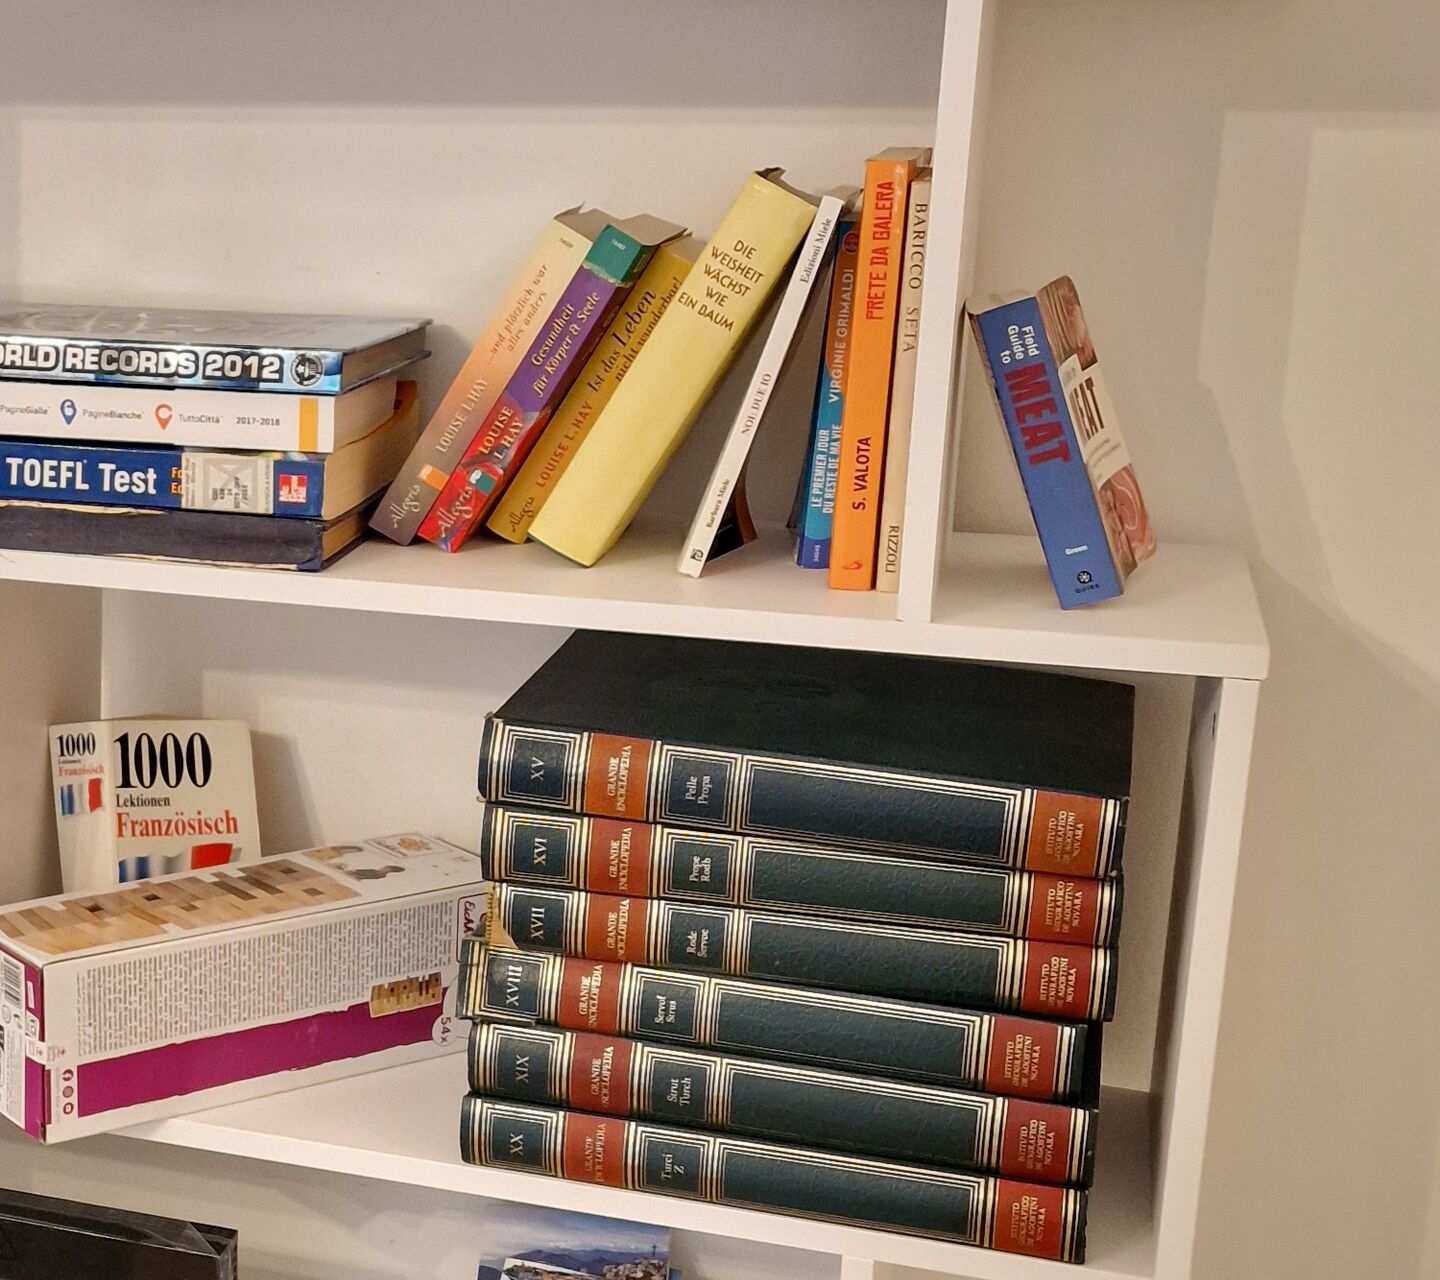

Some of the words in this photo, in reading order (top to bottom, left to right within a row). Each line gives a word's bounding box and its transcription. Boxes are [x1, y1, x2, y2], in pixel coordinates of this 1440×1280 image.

[733, 238, 758, 260] DIE
[799, 243, 823, 284] Edizioni
[818, 217, 833, 244] Miele
[870, 248, 889, 266] DA
[908, 202, 929, 290] BARICCO
[702, 262, 751, 298] WÄCHST
[710, 245, 766, 285] WEISHEIT
[502, 288, 536, 336] plötzlich
[533, 263, 549, 287] war
[676, 290, 699, 312] EIN
[697, 303, 736, 333] BAUM
[705, 284, 729, 308] WIE
[836, 268, 855, 337] GRIMALDI
[865, 271, 888, 321] PRETE
[506, 326, 524, 354] alles
[524, 290, 549, 326] anders
[531, 302, 576, 367] Gesundheit
[903, 307, 920, 353] SETA
[532, 370, 551, 398] für
[544, 333, 574, 380] Körper
[576, 290, 602, 325] Seele
[587, 374, 606, 394] Ist
[600, 346, 622, 375] das
[617, 290, 657, 348] Leben
[1007, 324, 1025, 360] Guide
[1021, 324, 1040, 357] Field
[64, 347, 197, 377] RECORDS
[204, 353, 282, 380] 2012
[614, 349, 638, 382] nicht
[827, 340, 848, 405] VIRGINIE
[999, 349, 1012, 365] to
[82, 408, 142, 420] PagineBianche
[236, 416, 281, 426] 2017-2018
[1003, 361, 1072, 466] MEAT
[435, 411, 467, 455] LOUISE
[478, 406, 514, 456] LOUISE
[501, 416, 525, 448] HAY
[817, 428, 830, 452] JOUR
[833, 423, 842, 440] VIE
[5, 457, 90, 491] TOEFL
[97, 462, 157, 495] Test
[536, 442, 569, 489] LOUISE
[813, 452, 827, 494] PREMIER
[828, 455, 839, 470] DE
[853, 436, 873, 493] VALOTA
[810, 494, 822, 508] LE
[824, 469, 837, 501] RESTE
[705, 497, 723, 529] Barbara
[822, 500, 834, 515] DU
[851, 496, 867, 511] S.
[885, 524, 900, 573] RIZZOLI
[57, 732, 96, 757] 1000
[113, 732, 212, 789] 1000
[58, 764, 105, 777] Französisch
[530, 756, 545, 781] XV
[607, 756, 620, 797] GRANDE
[115, 793, 171, 808] Lektionen
[684, 775, 699, 801] Pelle
[697, 774, 711, 805] Propa
[116, 809, 239, 838] Französisch
[533, 837, 548, 866] XVI
[609, 839, 621, 878] GRANDE
[689, 855, 701, 883] Prope
[700, 857, 712, 883] Rodb
[530, 906, 546, 941] XVII
[607, 911, 618, 949] GRANDE
[686, 929, 698, 954] Rode
[698, 927, 710, 958] Servoc
[505, 964, 523, 1007] XVIII
[578, 975, 591, 1016] GRANDE
[654, 994, 667, 1024] Servof
[666, 999, 677, 1023] Strus
[440, 1015, 453, 1044] 54x
[514, 1054, 531, 1084] XIX
[590, 1057, 602, 1096] GRANDE
[666, 1077, 680, 1103] Strut
[679, 1076, 693, 1106] Turch
[509, 1131, 525, 1156] XX
[661, 1152, 674, 1181] Turci
[673, 1163, 686, 1176] Z
